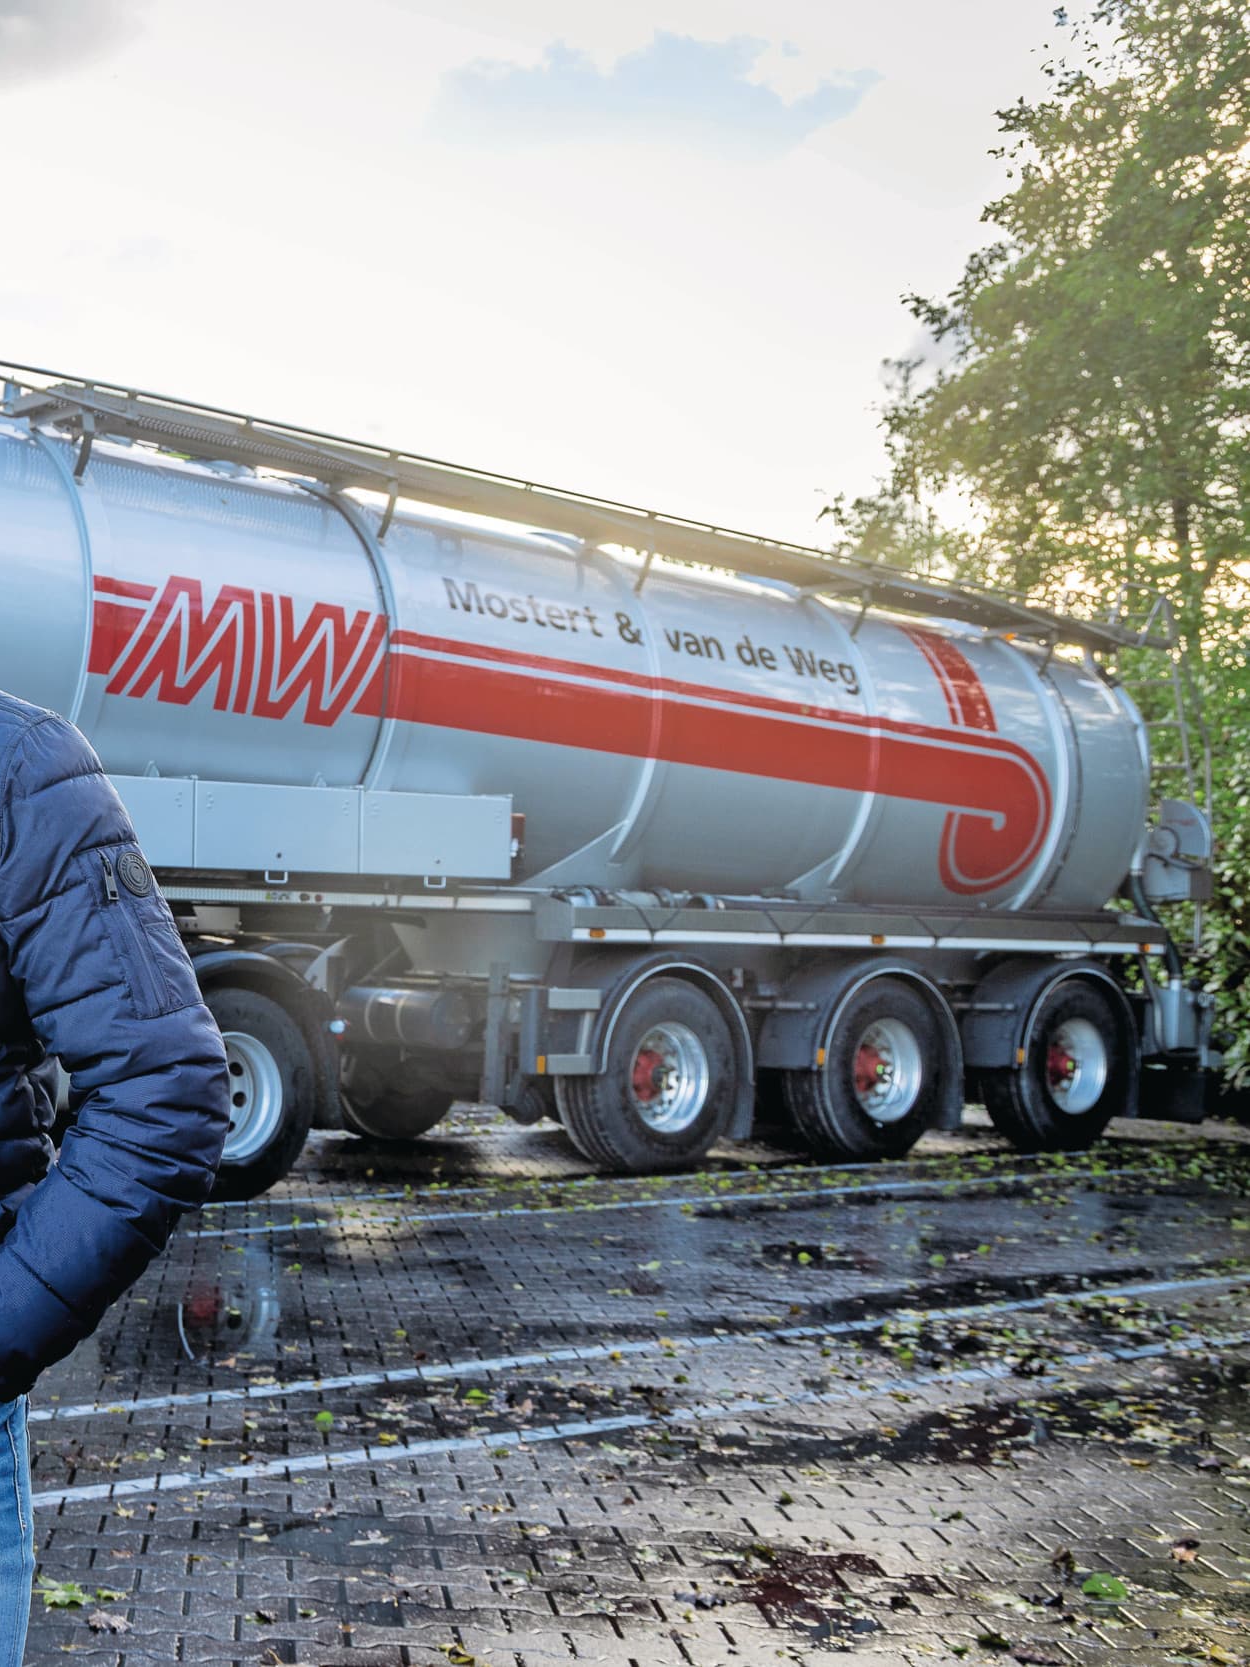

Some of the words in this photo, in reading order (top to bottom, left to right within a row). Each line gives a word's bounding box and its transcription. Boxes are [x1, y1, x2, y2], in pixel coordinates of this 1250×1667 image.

[105, 575, 390, 728] MW
[442, 576, 604, 638] Mostert
[614, 611, 645, 647] &
[664, 627, 727, 662] van
[736, 634, 776, 672] de
[784, 644, 862, 696] Weg
